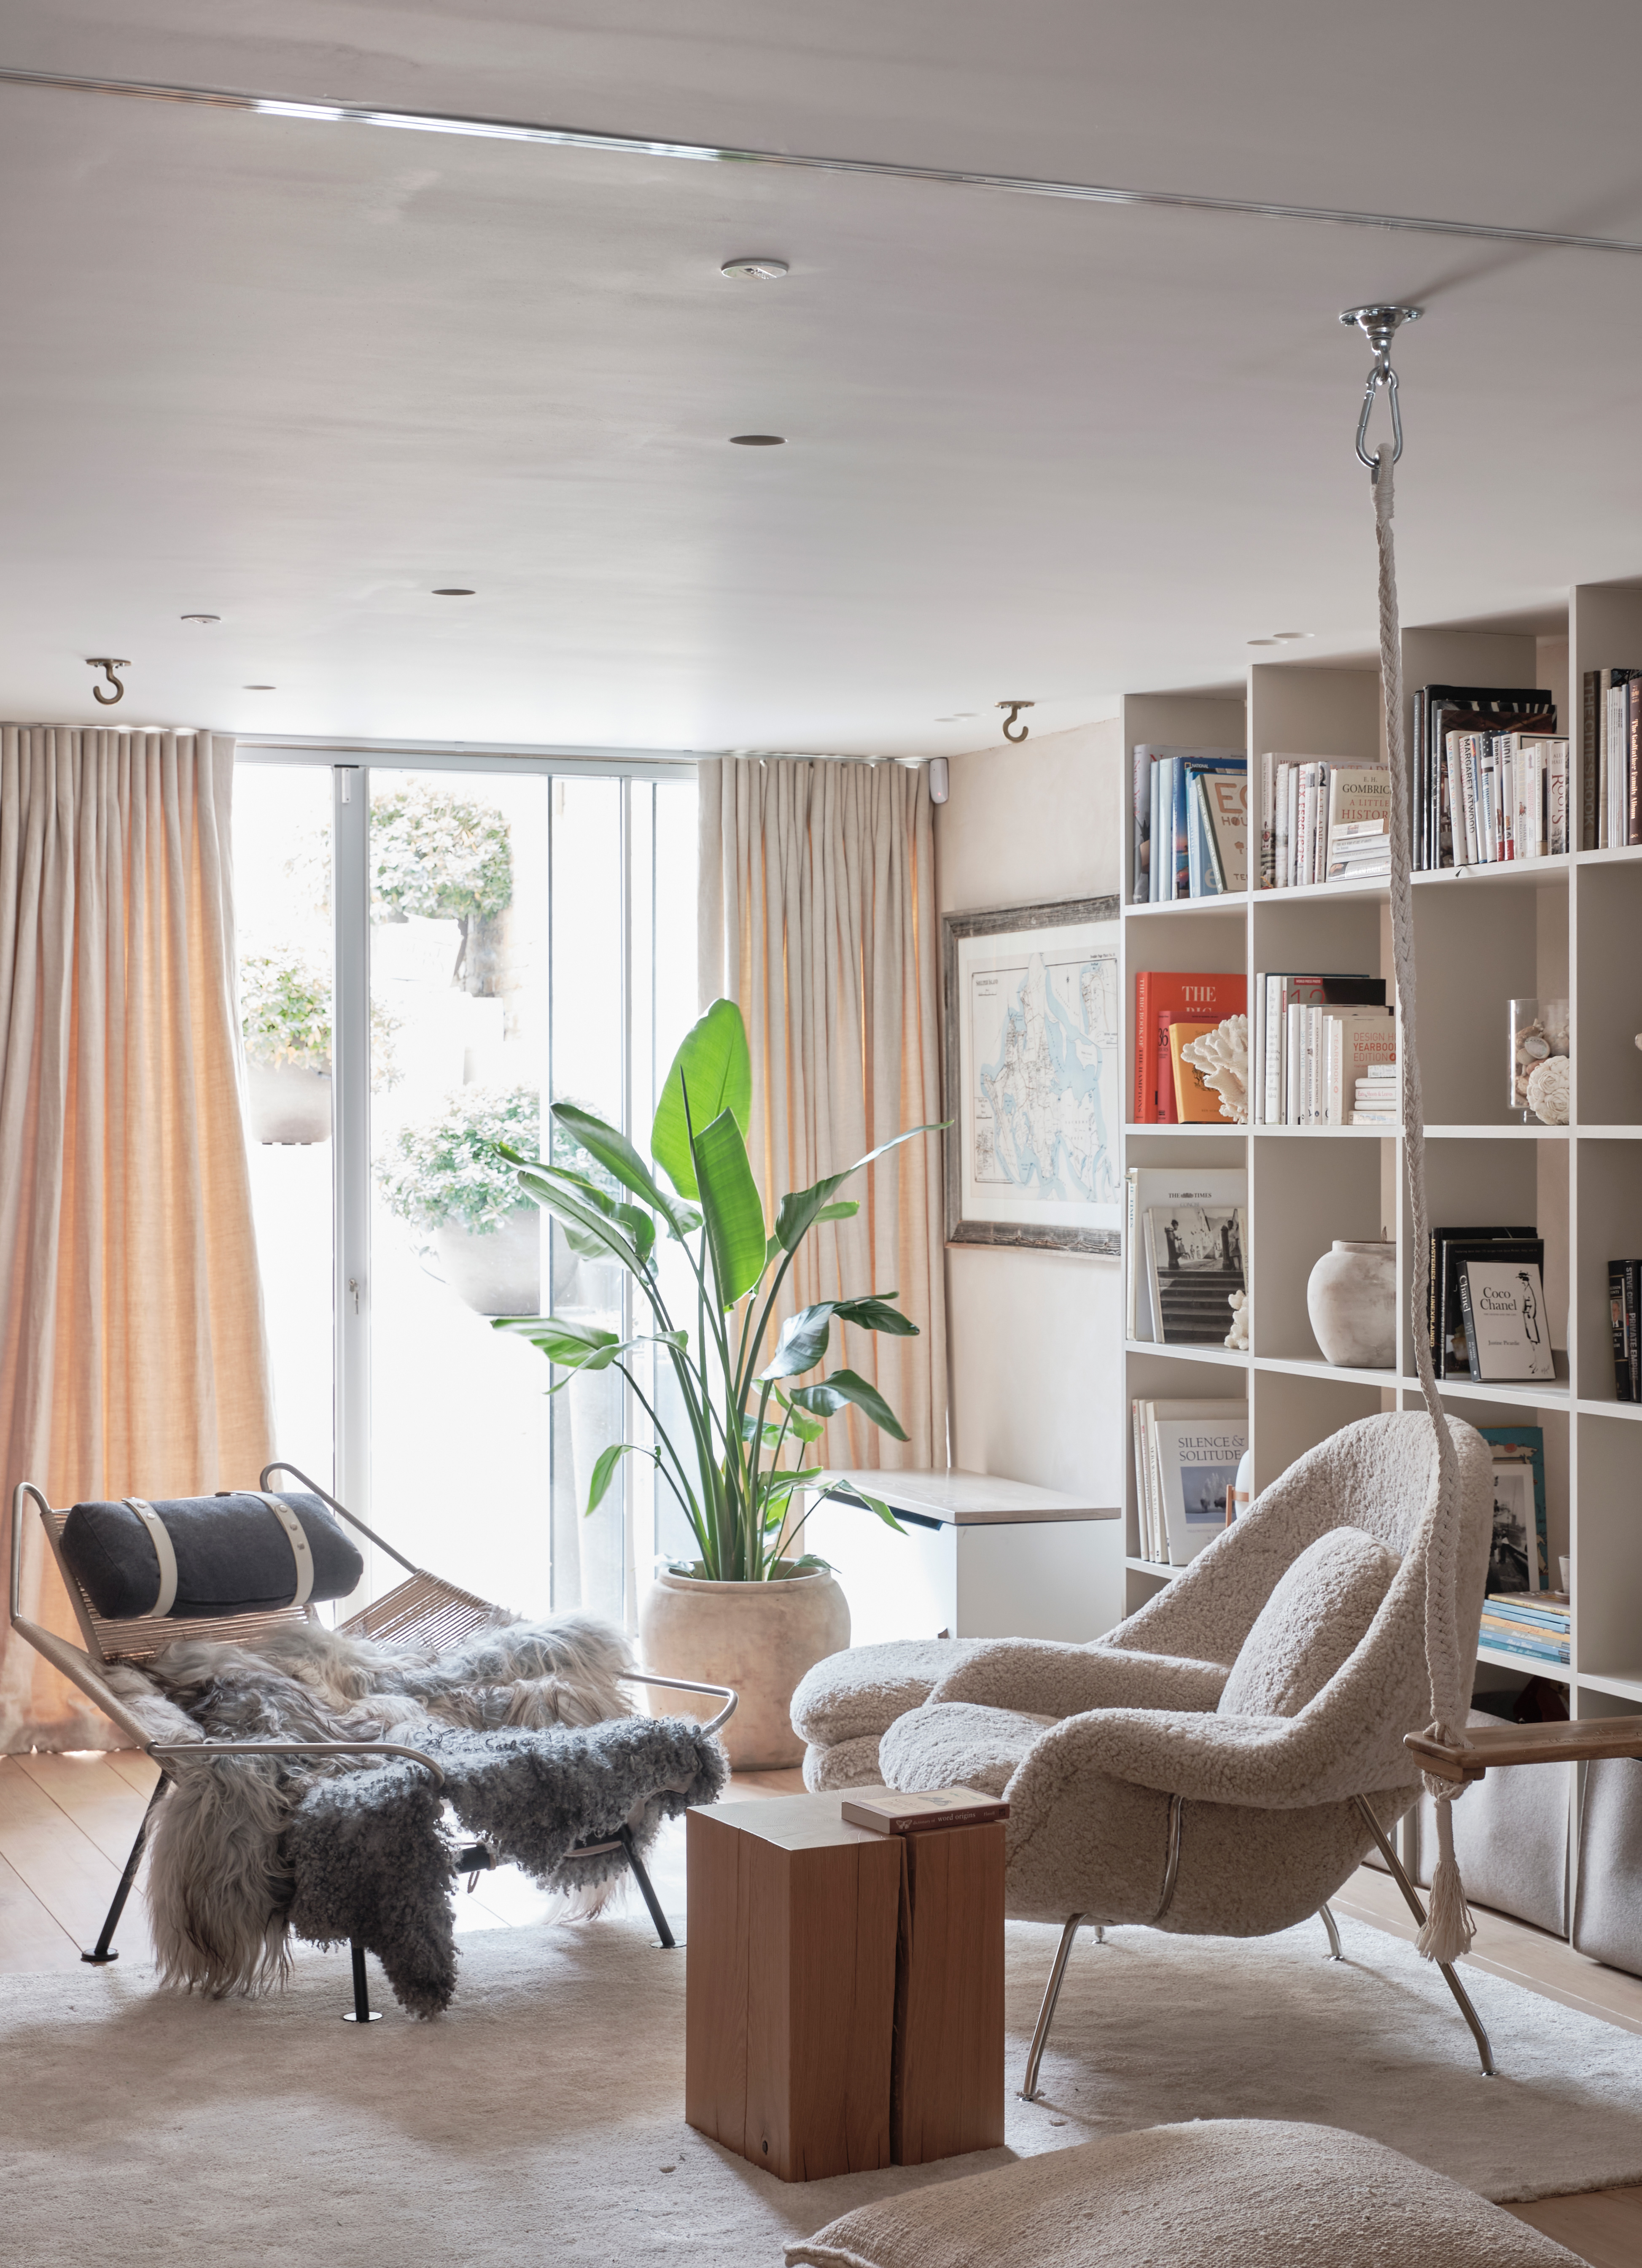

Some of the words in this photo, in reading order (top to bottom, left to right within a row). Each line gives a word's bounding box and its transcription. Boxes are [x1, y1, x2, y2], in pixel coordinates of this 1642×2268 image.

[1584, 682, 1594, 716] THE
[1502, 737, 1511, 766] INDIA
[1584, 719, 1594, 774] CITIES
[1464, 739, 1472, 790] MARGARET
[1343, 784, 1391, 794] GOMBRIC
[1359, 799, 1389, 807] LITTLE
[1584, 777, 1594, 826] BOOK
[1341, 809, 1389, 820] HISTOR
[1483, 788, 1491, 831] UNWINDING
[1198, 796, 1207, 814] HOUSE
[1206, 832, 1214, 856] TERENCE
[1211, 857, 1219, 879] CONRAN
[1297, 803, 1305, 862] FERGUSON
[1182, 986, 1216, 1002] THE
[1290, 988, 1325, 1004] 12
[1139, 1035, 1144, 1046] OF
[1354, 1033, 1385, 1041] DESIGN
[1353, 1043, 1396, 1052] YEARBOO
[1354, 1053, 1388, 1062] EDITION
[1459, 1275, 1471, 1313] Chanel
[1483, 1286, 1511, 1299] Coco
[1480, 1299, 1517, 1311] Chanel
[1629, 1313, 1637, 1347] PRIVATE
[1178, 1437, 1230, 1448] SILENCE
[1232, 1435, 1245, 1447] &
[1179, 1450, 1241, 1462] SOLITUDE
[1152, 1486, 1157, 1496] ON
[938, 1814, 953, 1822] word
[955, 1812, 976, 1821] origins
